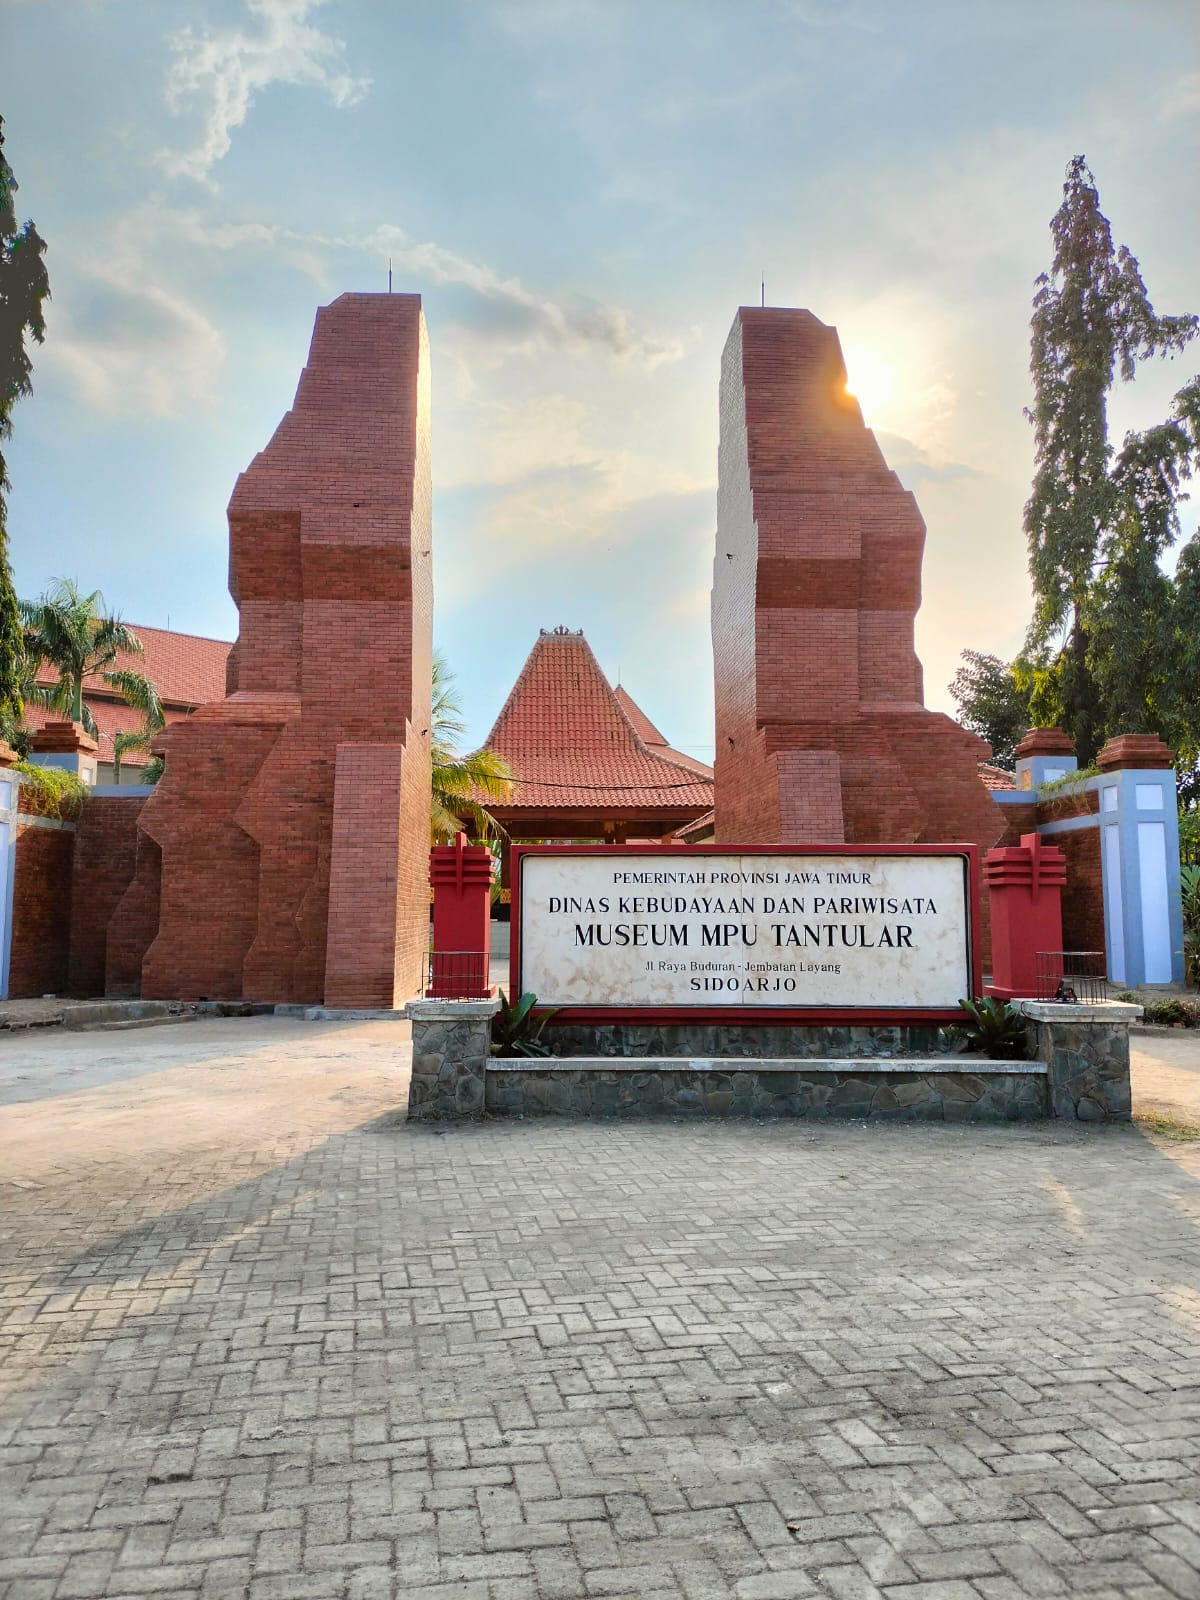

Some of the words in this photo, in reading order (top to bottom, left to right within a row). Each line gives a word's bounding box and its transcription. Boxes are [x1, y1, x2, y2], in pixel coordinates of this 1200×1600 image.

[613, 872, 706, 884] PEMERINTAH
[710, 872, 780, 884] PROVINSI
[784, 873, 821, 885] JAWA
[826, 873, 872, 885] TIMUR
[548, 897, 610, 914] DINAS
[619, 897, 755, 914] KEBUDAYAAN
[762, 897, 805, 914] DAN
[813, 897, 937, 915] PARIWISATA
[574, 924, 689, 947] MUSEUM
[701, 924, 758, 947] MPU
[770, 924, 914, 948] TANTULAR
[658, 961, 687, 974] Raya
[690, 961, 735, 972] Buduran
[744, 961, 797, 972] Jembatan
[799, 961, 841, 974] Layang
[690, 977, 797, 992] SIDOARJO
